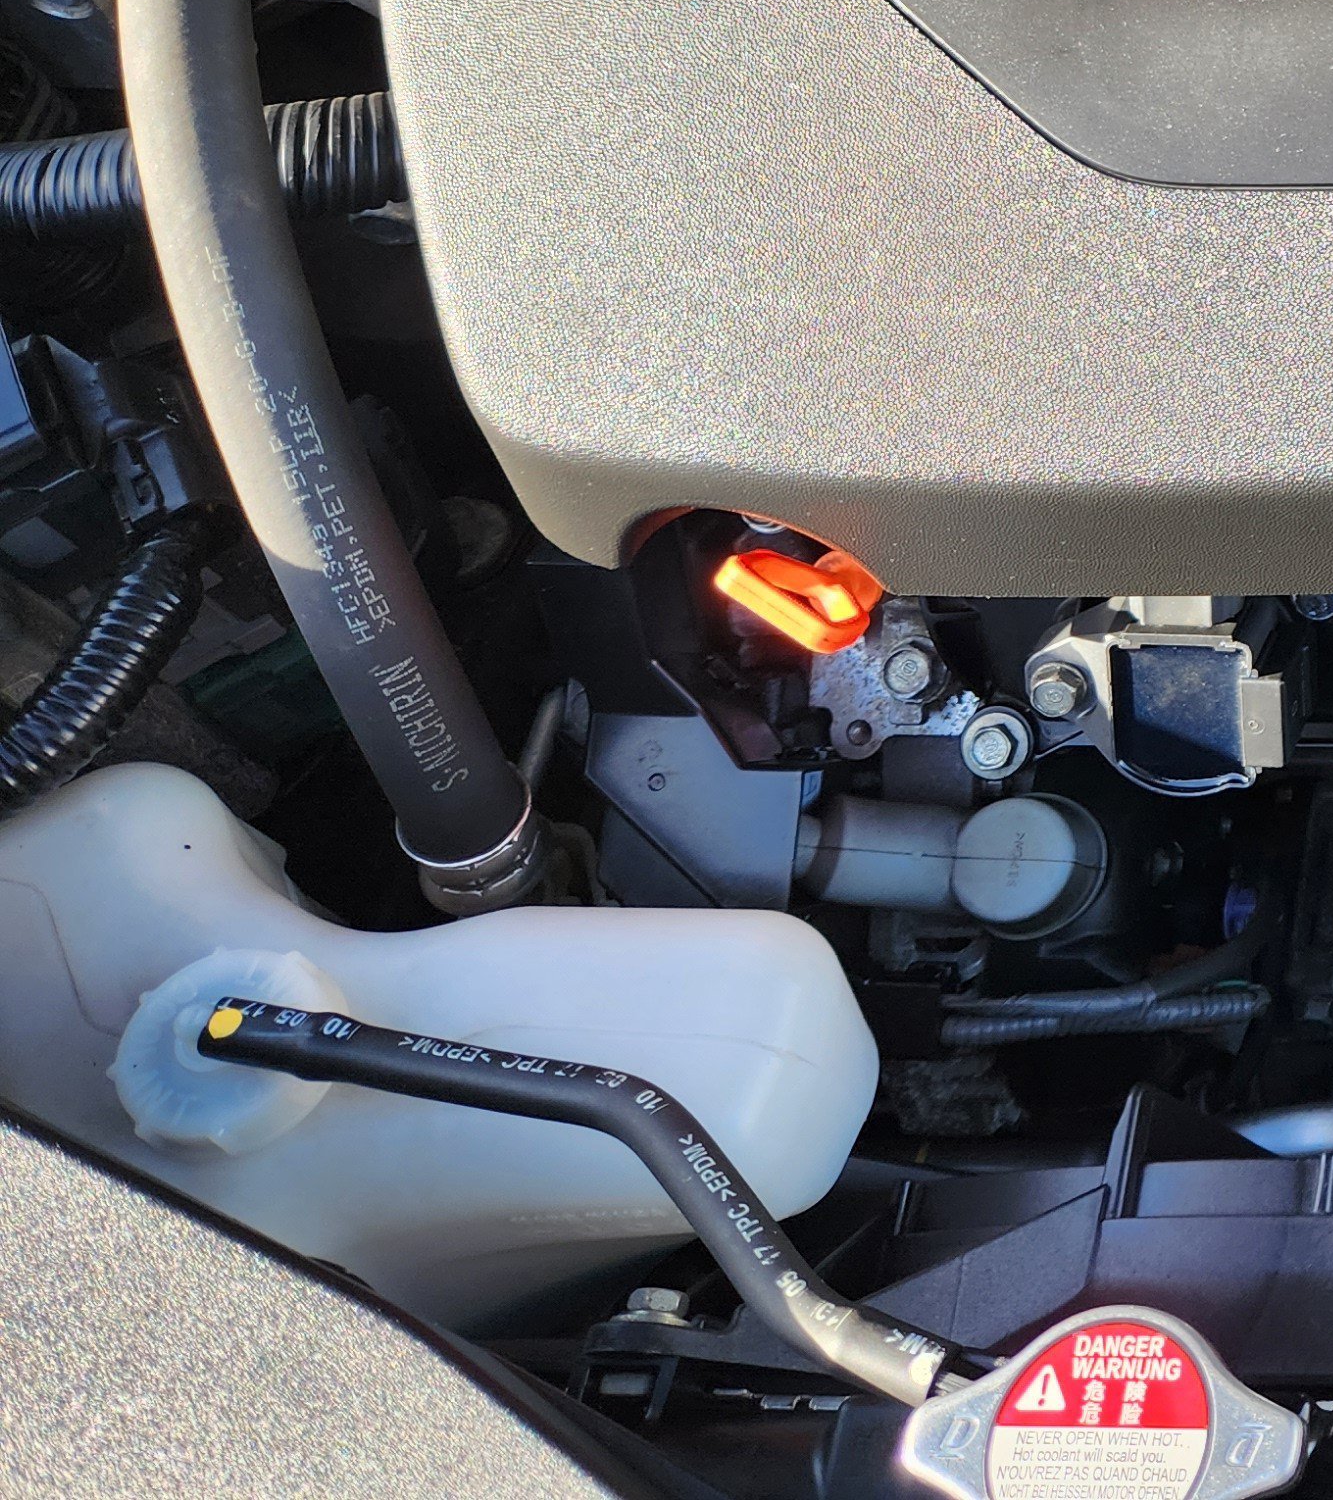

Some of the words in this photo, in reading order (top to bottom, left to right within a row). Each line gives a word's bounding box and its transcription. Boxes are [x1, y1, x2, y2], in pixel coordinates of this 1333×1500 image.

[726, 1201, 765, 1244] TPC
[1073, 1334, 1165, 1358] DANGER
[1071, 1357, 1183, 1380] WARNUNG
[1016, 1431, 1062, 1445] NEVER
[1066, 1431, 1106, 1445] OPEN
[1108, 1432, 1148, 1446] WHEN
[1013, 1448, 1034, 1462] Hot
[1037, 1448, 1080, 1462] coolant
[1084, 1448, 1103, 1462] will
[1105, 1448, 1138, 1463] scald
[1141, 1451, 1166, 1466] you.
[997, 1465, 1061, 1480] N'OUVREZ
[1064, 1466, 1090, 1481] PAS
[1093, 1467, 1139, 1482] QUAND
[1142, 1468, 1190, 1483] CHAUD.
[999, 1484, 1030, 1499] NICHT
[1033, 1484, 1051, 1499] BEI
[1052, 1485, 1096, 1500] HEISSEM
[1097, 1485, 1135, 1500] MOTOR
